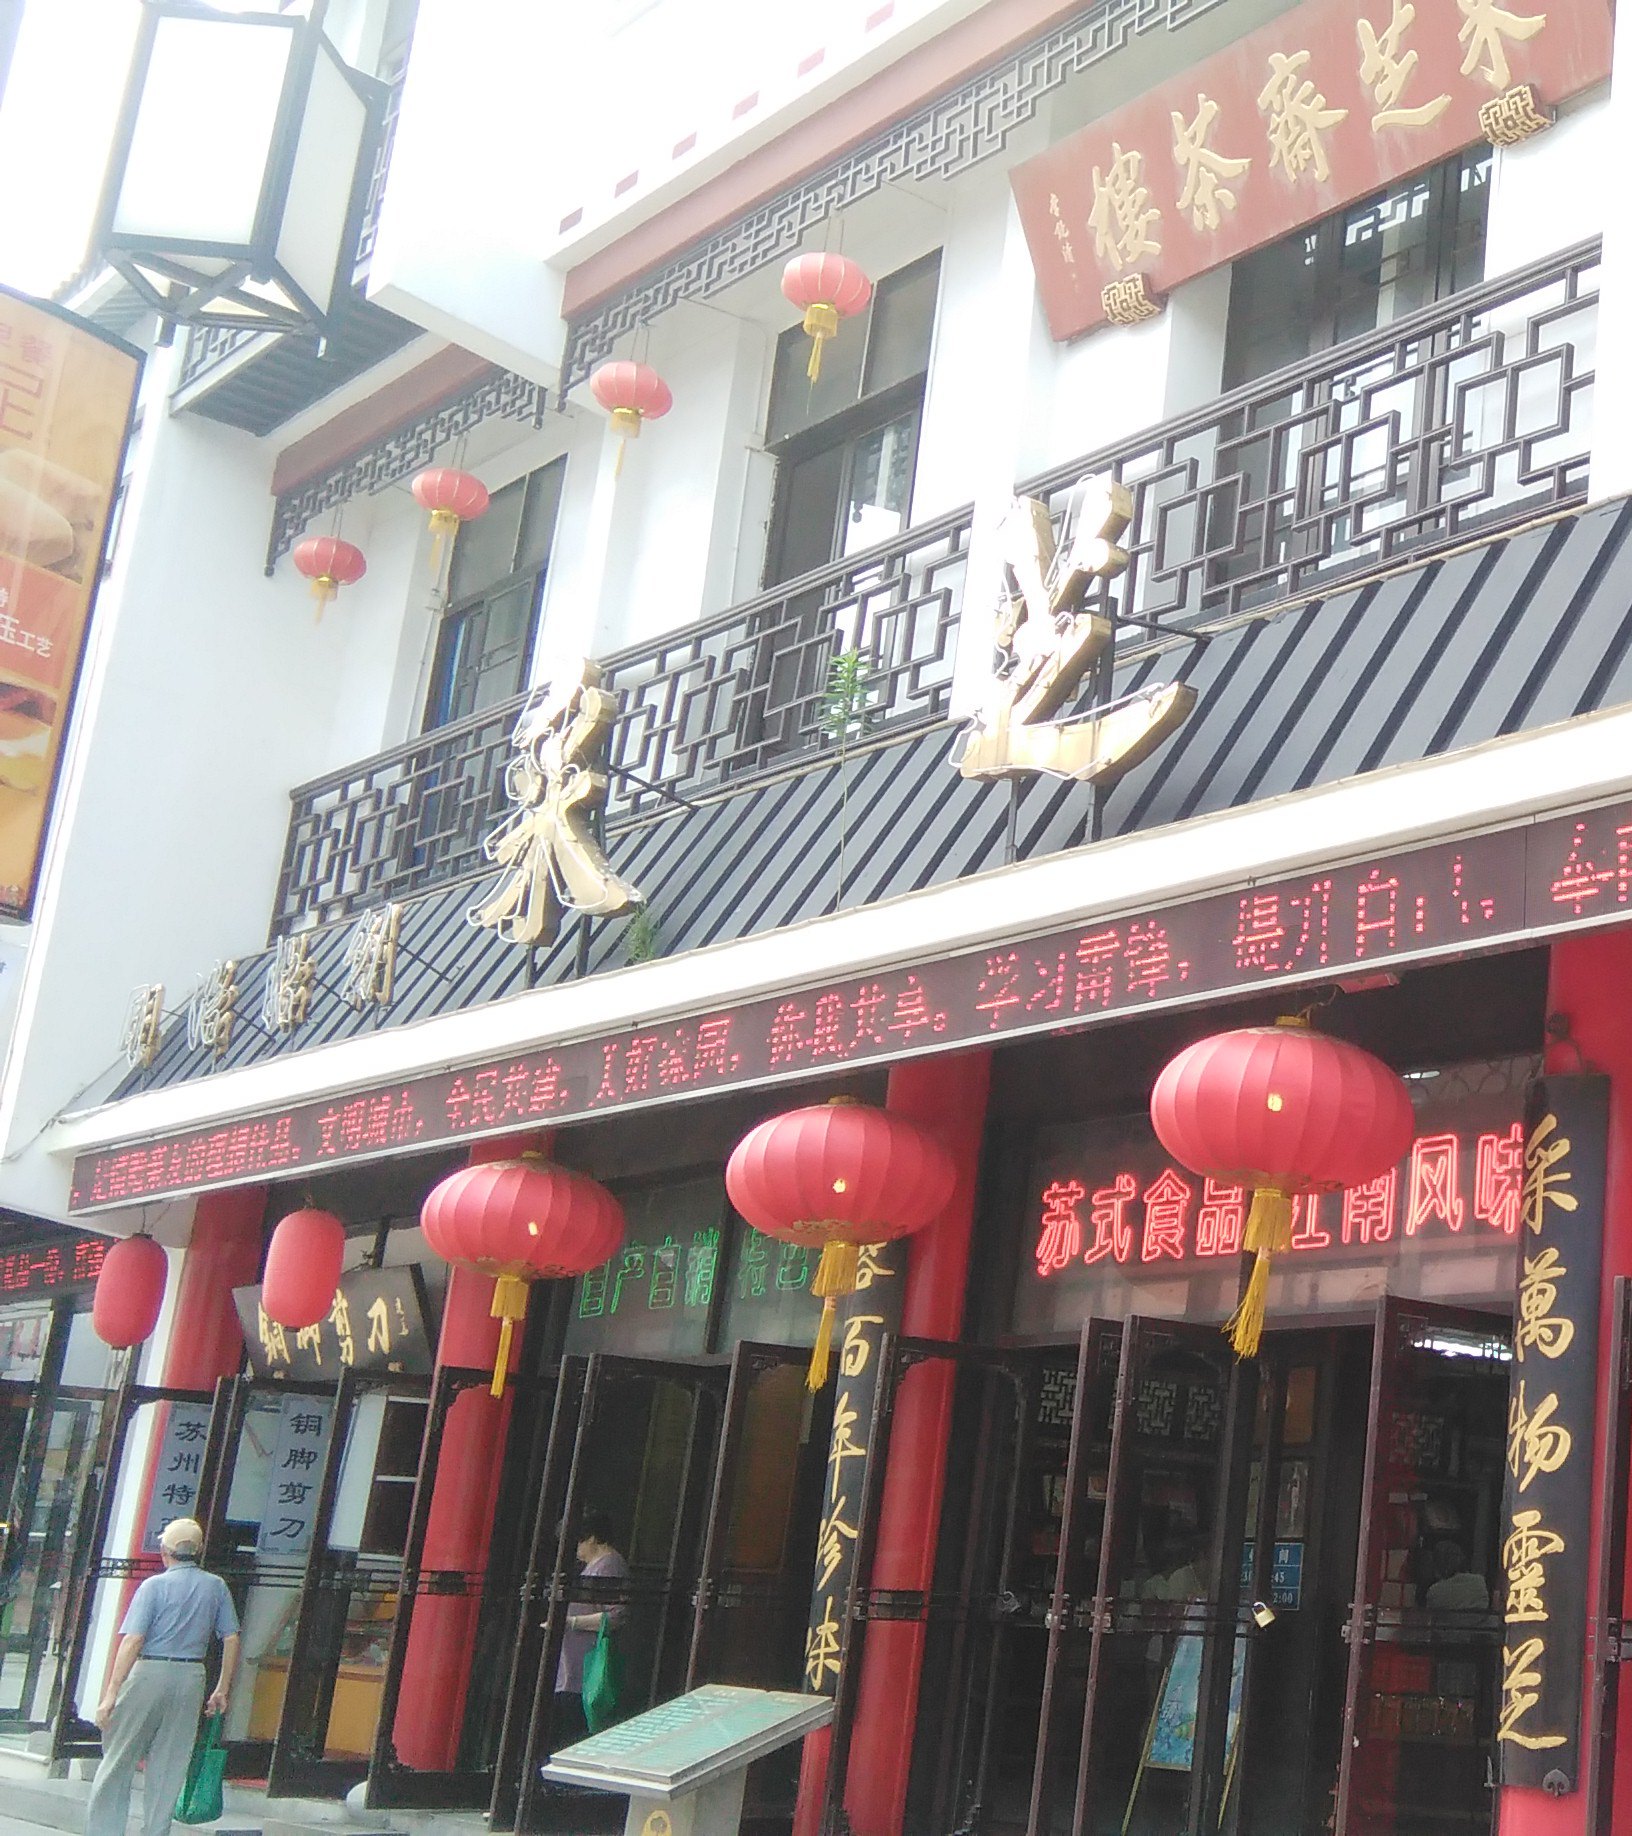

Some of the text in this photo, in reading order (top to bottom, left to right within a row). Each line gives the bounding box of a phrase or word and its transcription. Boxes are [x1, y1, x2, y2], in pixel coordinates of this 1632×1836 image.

[1035, 1167, 1245, 1278] 苏式食品
[155, 1420, 208, 1537] 苏州特
